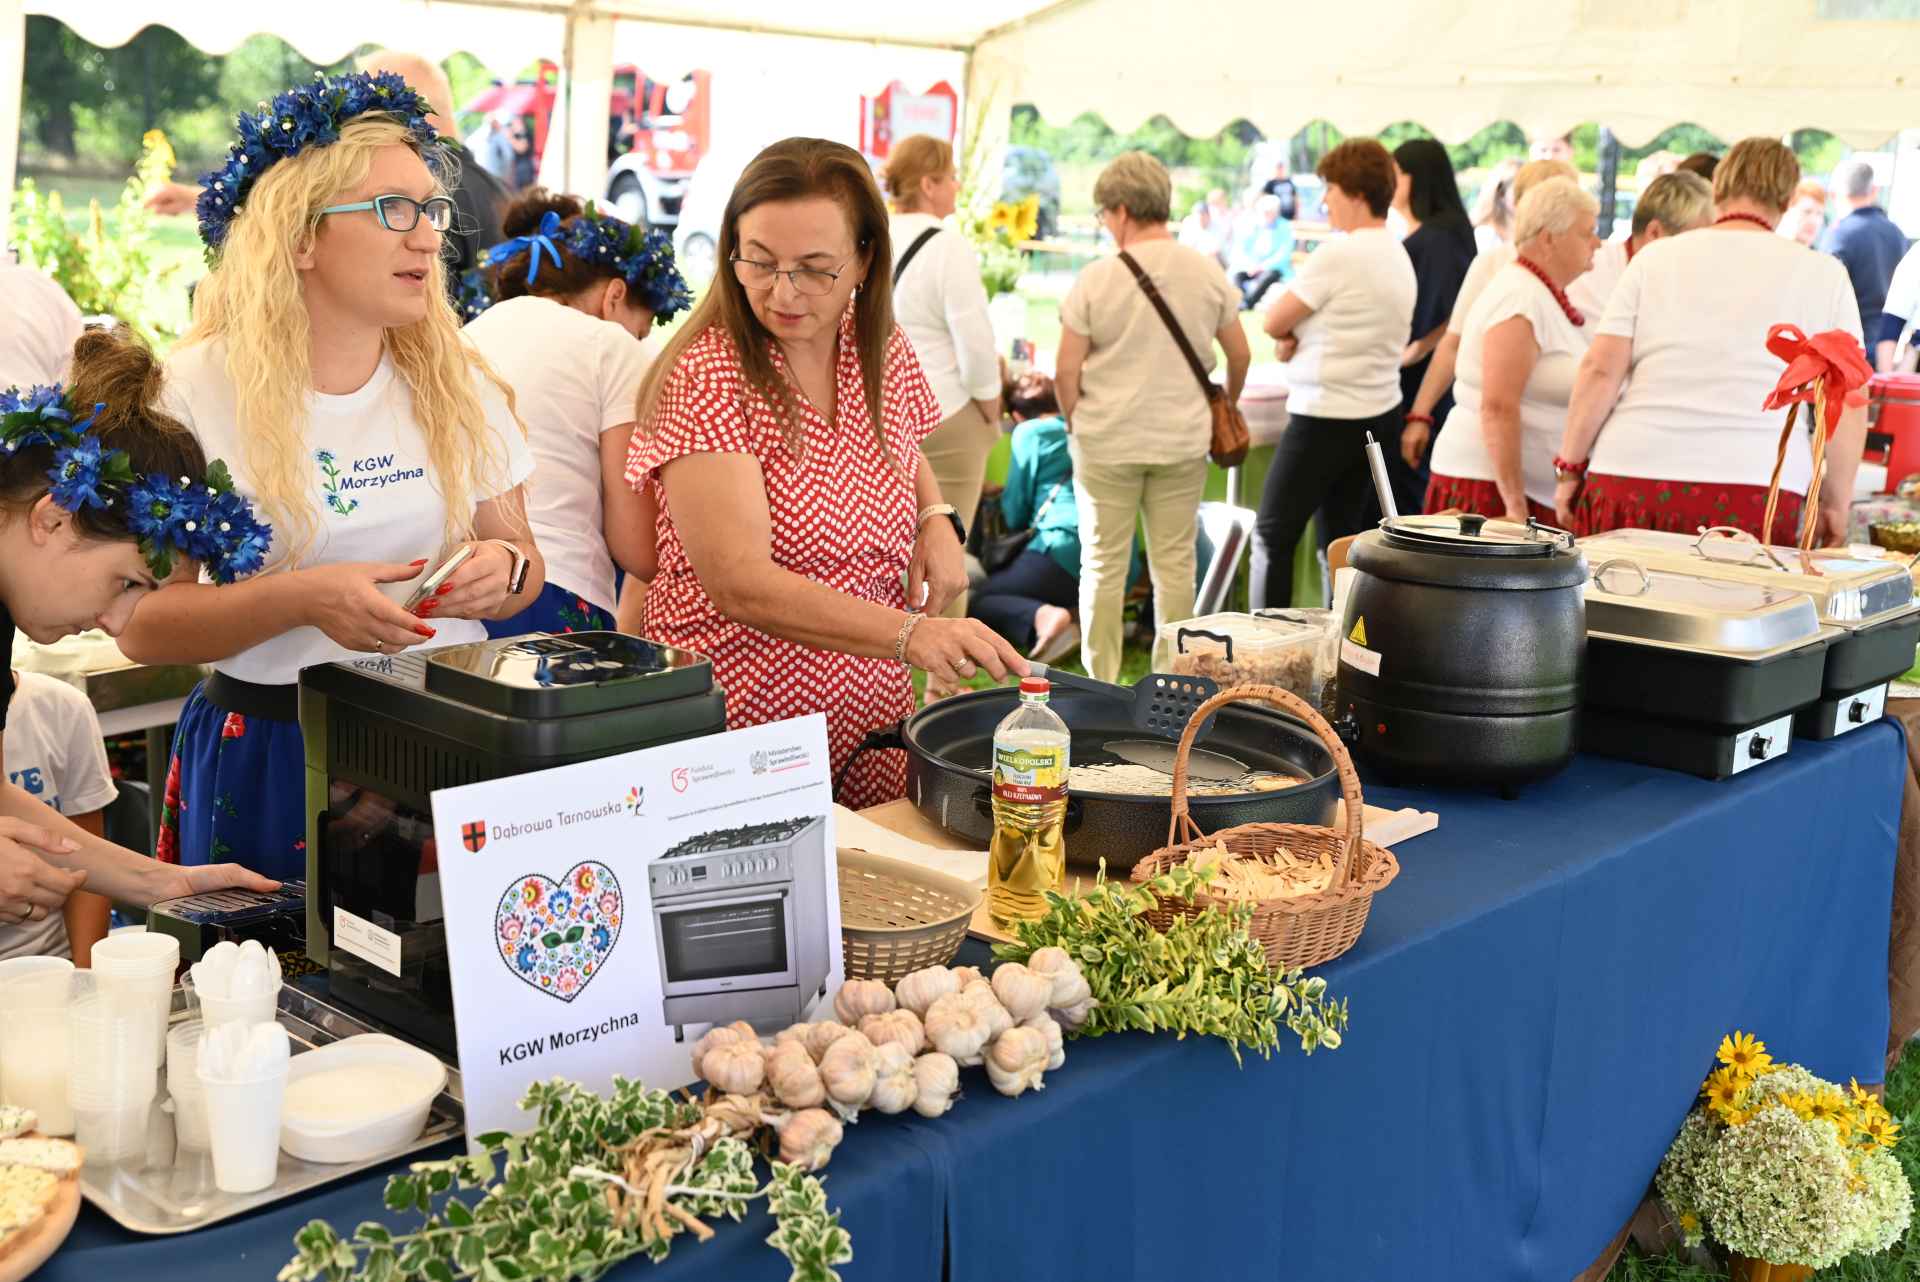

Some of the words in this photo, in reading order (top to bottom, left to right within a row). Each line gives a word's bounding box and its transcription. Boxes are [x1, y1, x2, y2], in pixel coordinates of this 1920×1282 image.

[353, 454, 394, 472] KGW
[340, 468, 423, 490] Morzychna
[998, 753, 1053, 766] WIELKOPOLSKI
[493, 817, 552, 840] Dąbrowa
[557, 801, 622, 826] Tarnowska
[499, 1037, 545, 1066] KGW
[549, 1012, 639, 1050] Morzychna
